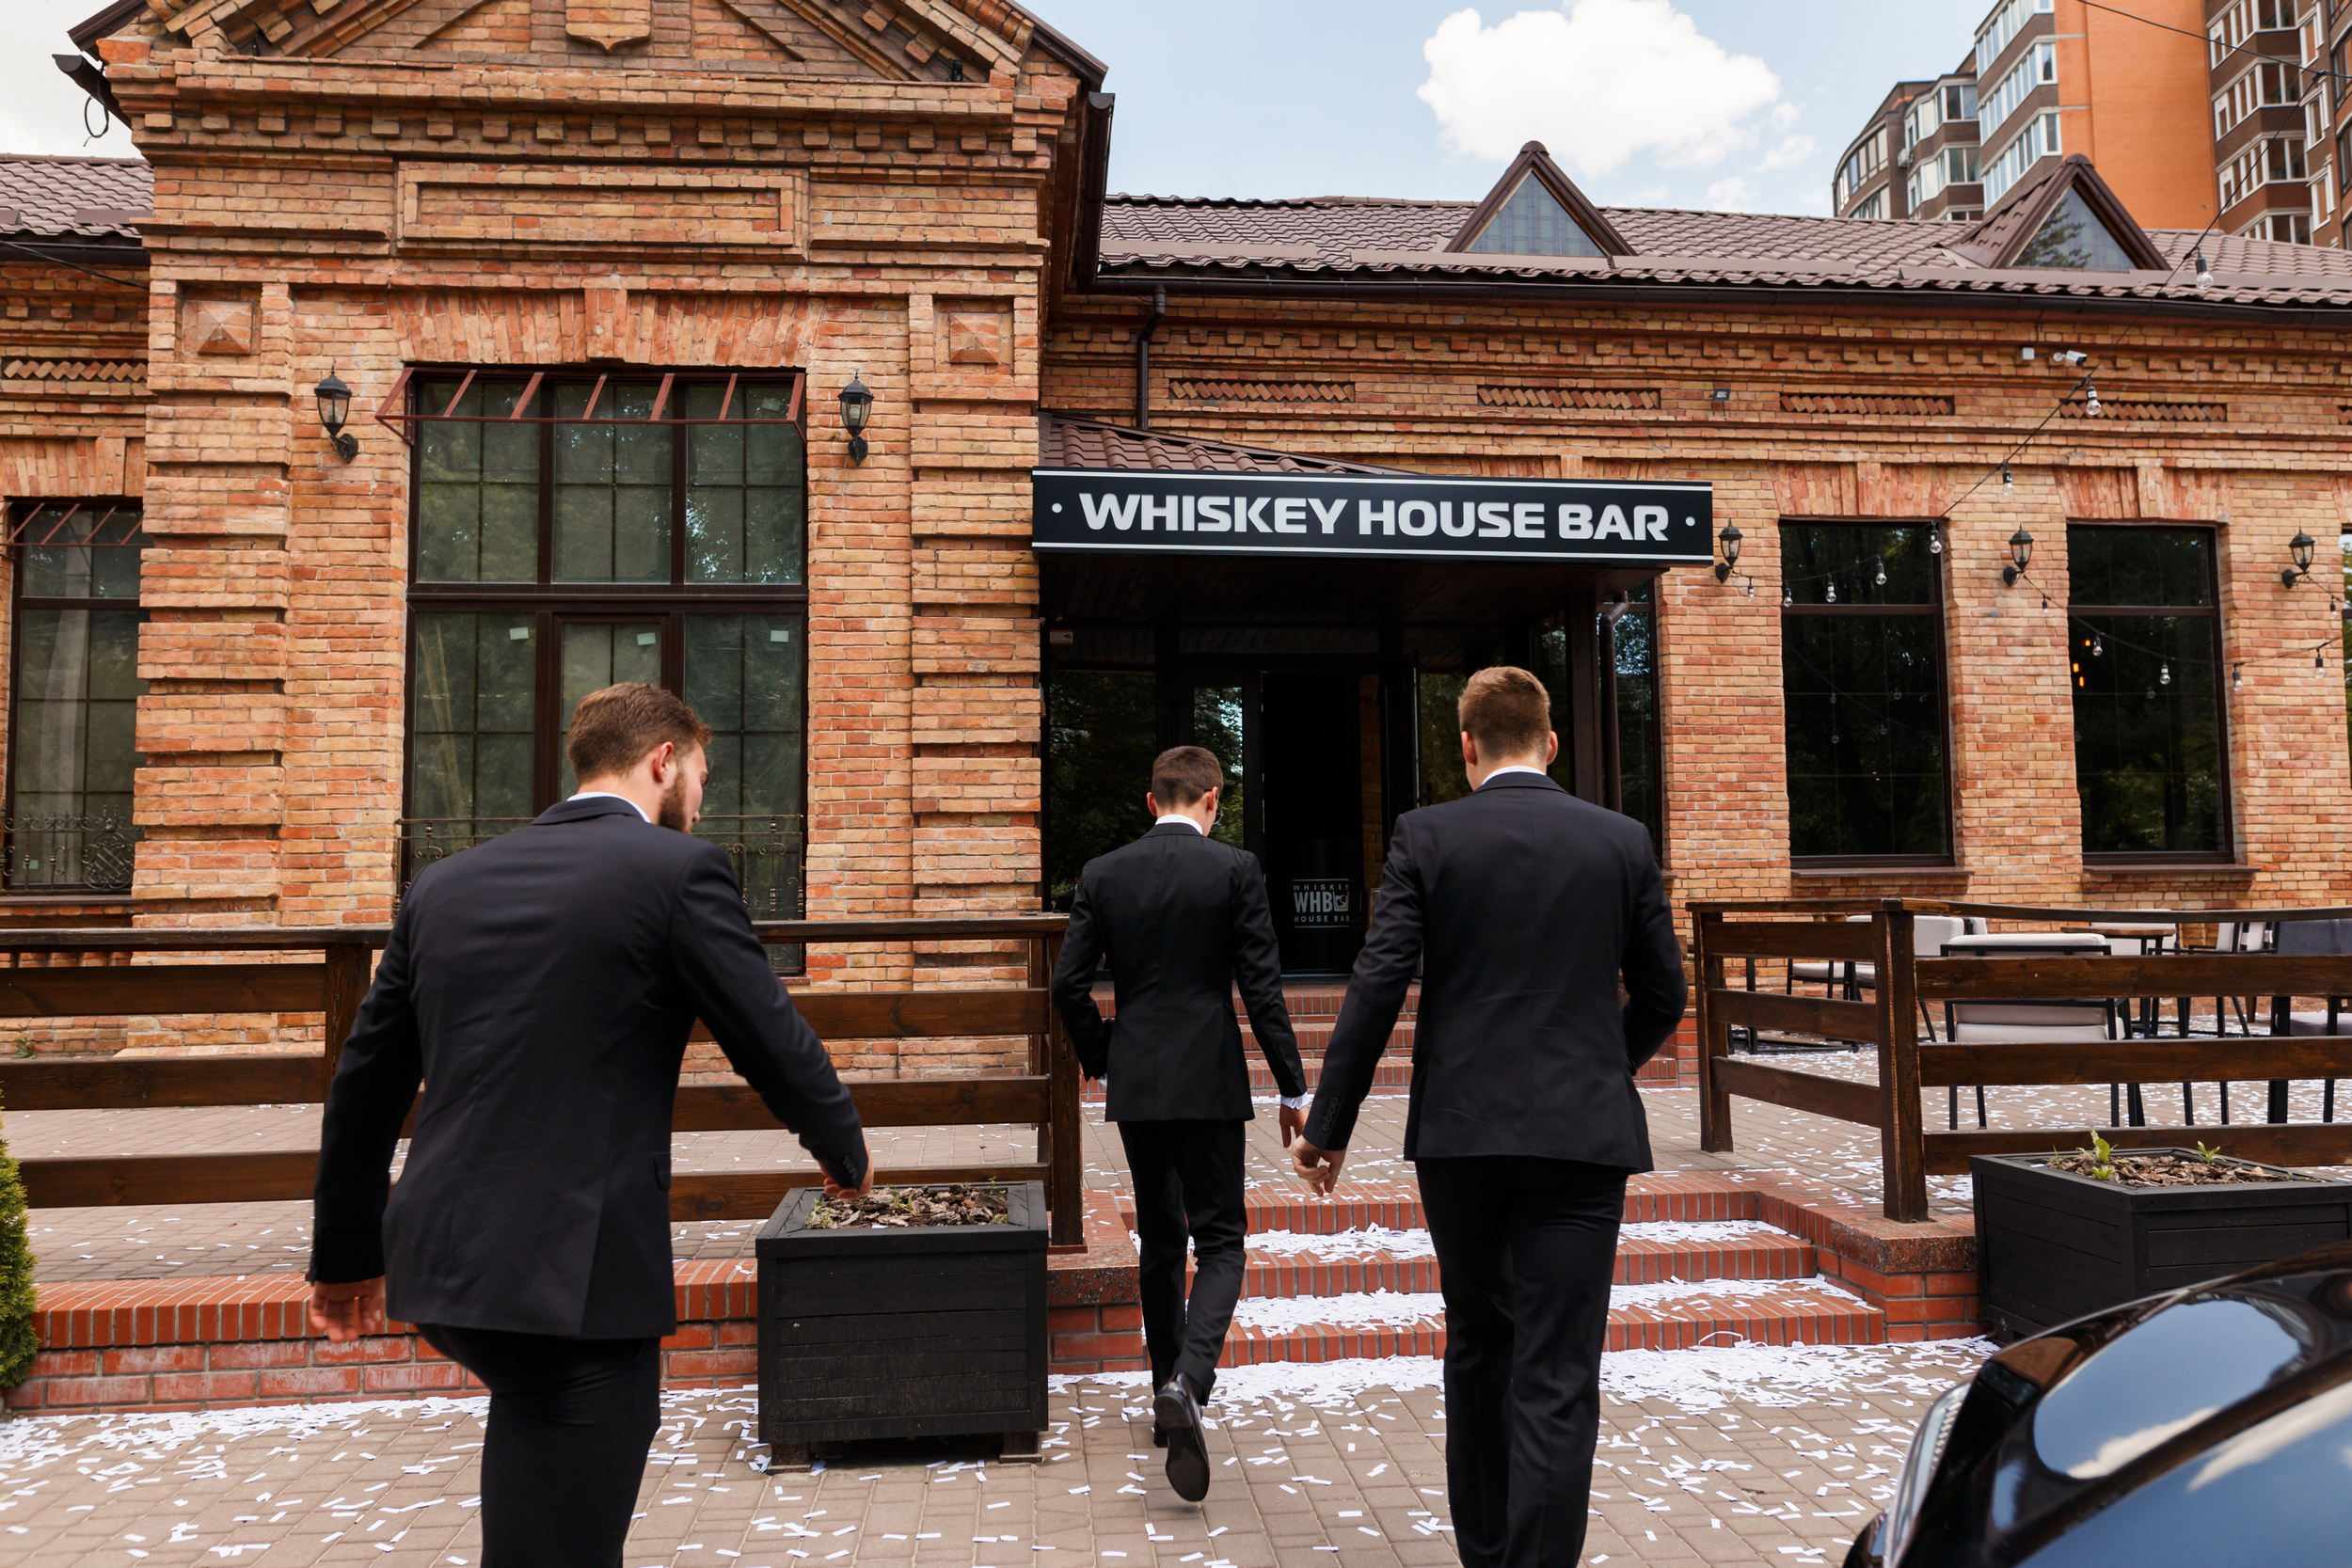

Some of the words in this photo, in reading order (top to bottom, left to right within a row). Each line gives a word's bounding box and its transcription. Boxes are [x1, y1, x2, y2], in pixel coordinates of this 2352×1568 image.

[1078, 492, 1349, 535] WHISKEY
[1359, 499, 1546, 539] HOUSE
[1558, 503, 1669, 542] BAR
[1293, 891, 1333, 913] WHB
